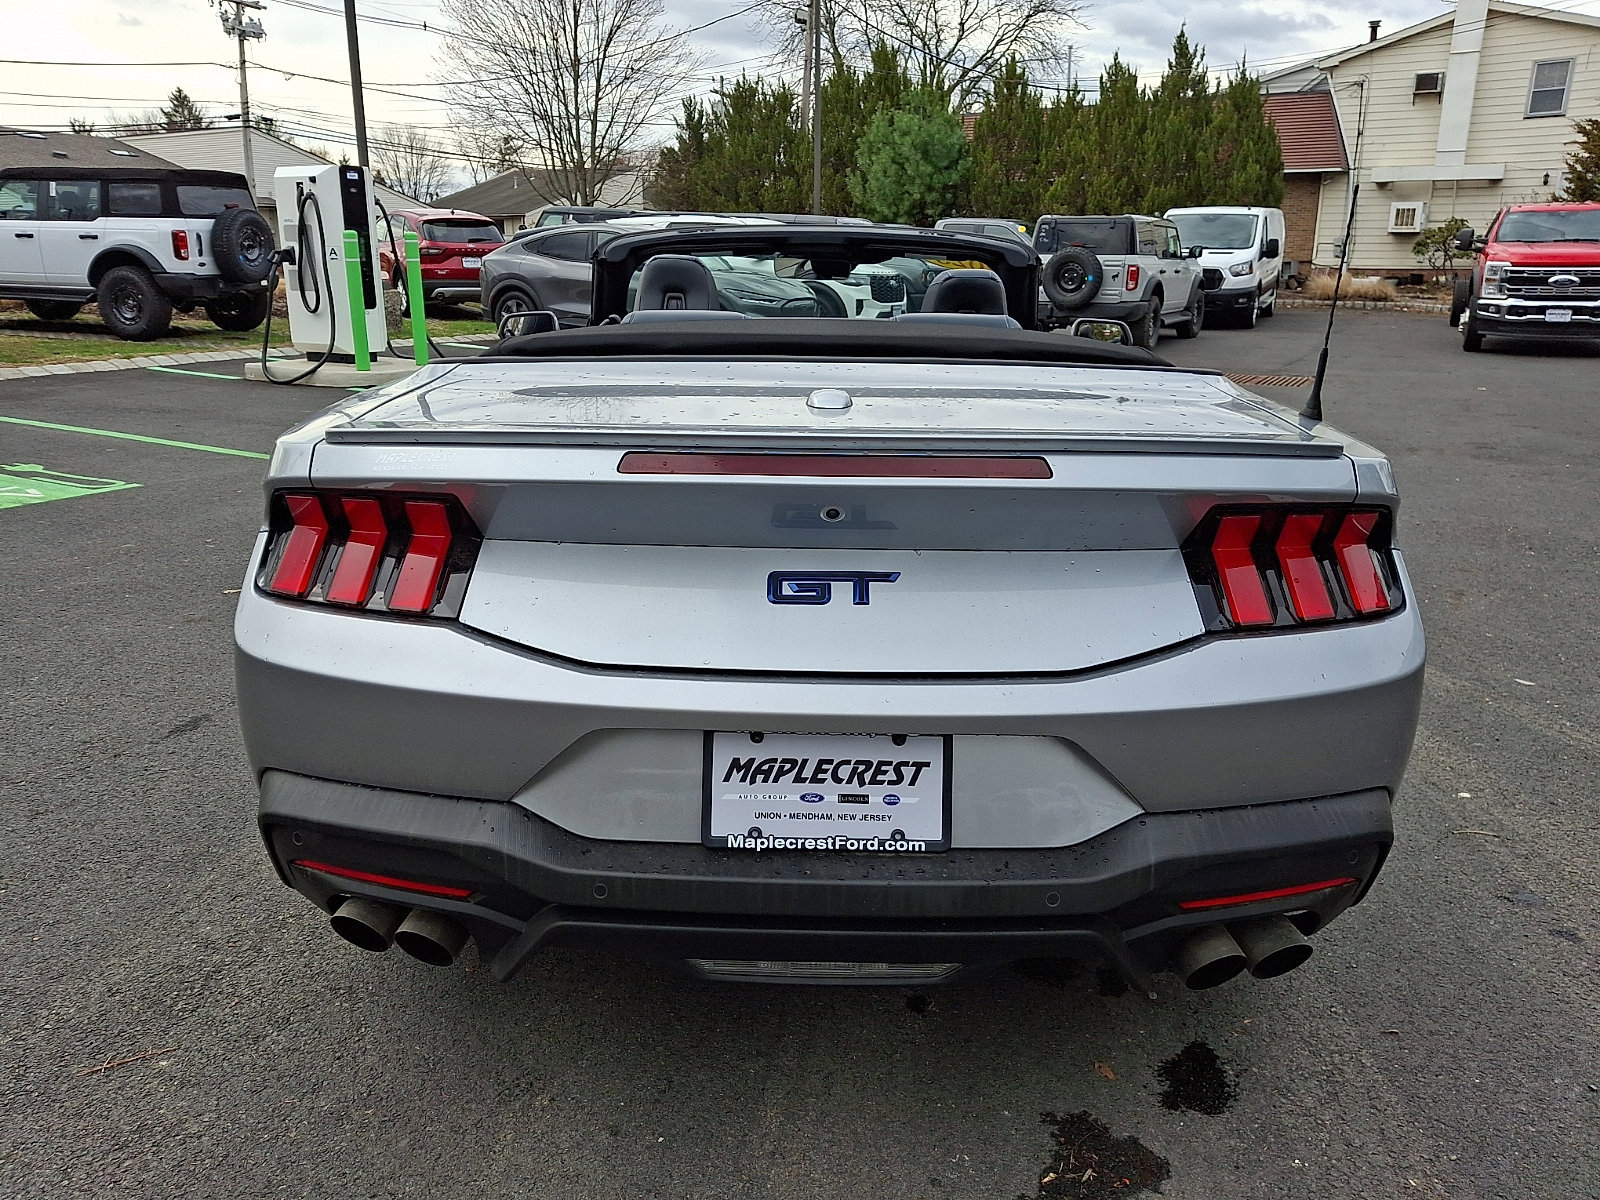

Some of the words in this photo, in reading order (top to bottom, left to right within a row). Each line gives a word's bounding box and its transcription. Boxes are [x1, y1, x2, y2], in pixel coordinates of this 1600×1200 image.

[328, 247, 338, 257] A
[767, 571, 901, 605] GT
[722, 757, 931, 788] MAPLECREST
[803, 793, 821, 803] Ford
[754, 811, 782, 820] UNION
[789, 812, 835, 821] MENDHAM,
[838, 813, 857, 821] NEW
[859, 813, 893, 822] JERSEY
[727, 834, 926, 851] MaplecrestFord.com
